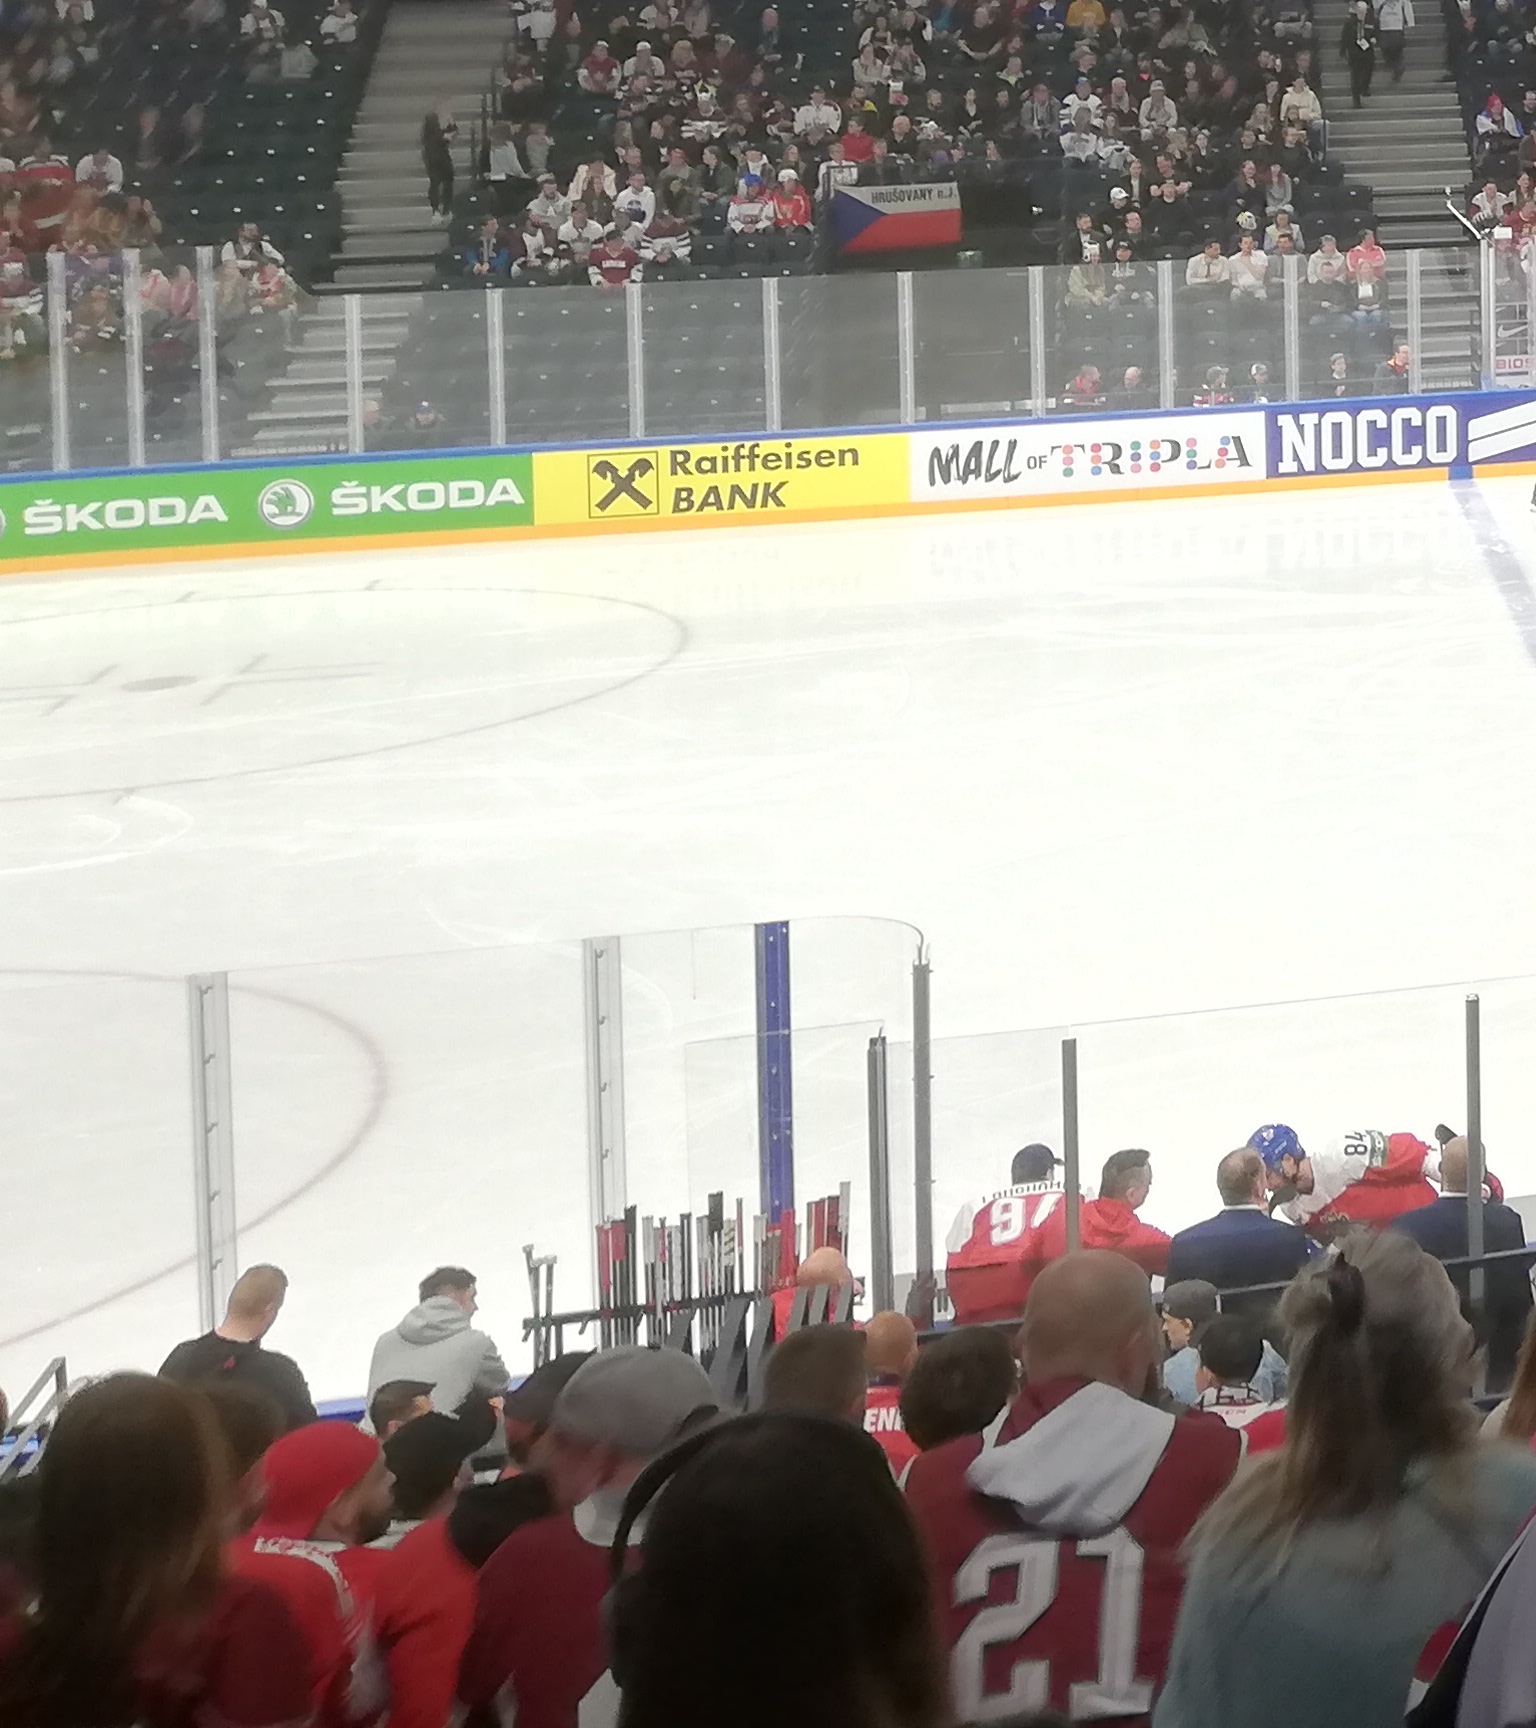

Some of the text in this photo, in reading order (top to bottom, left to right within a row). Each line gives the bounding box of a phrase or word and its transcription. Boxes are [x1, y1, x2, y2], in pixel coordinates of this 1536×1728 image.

[871, 187, 933, 204] HRUŠOVANY
[1276, 403, 1458, 473] NOCCO
[669, 442, 859, 477] Raiffeisen
[927, 435, 1253, 488] MALL OF TRIPLA
[23, 493, 229, 537] ŠKODA
[331, 476, 524, 517] ŠKODA
[672, 480, 790, 514] BANK
[950, 1524, 1158, 1722] 21
